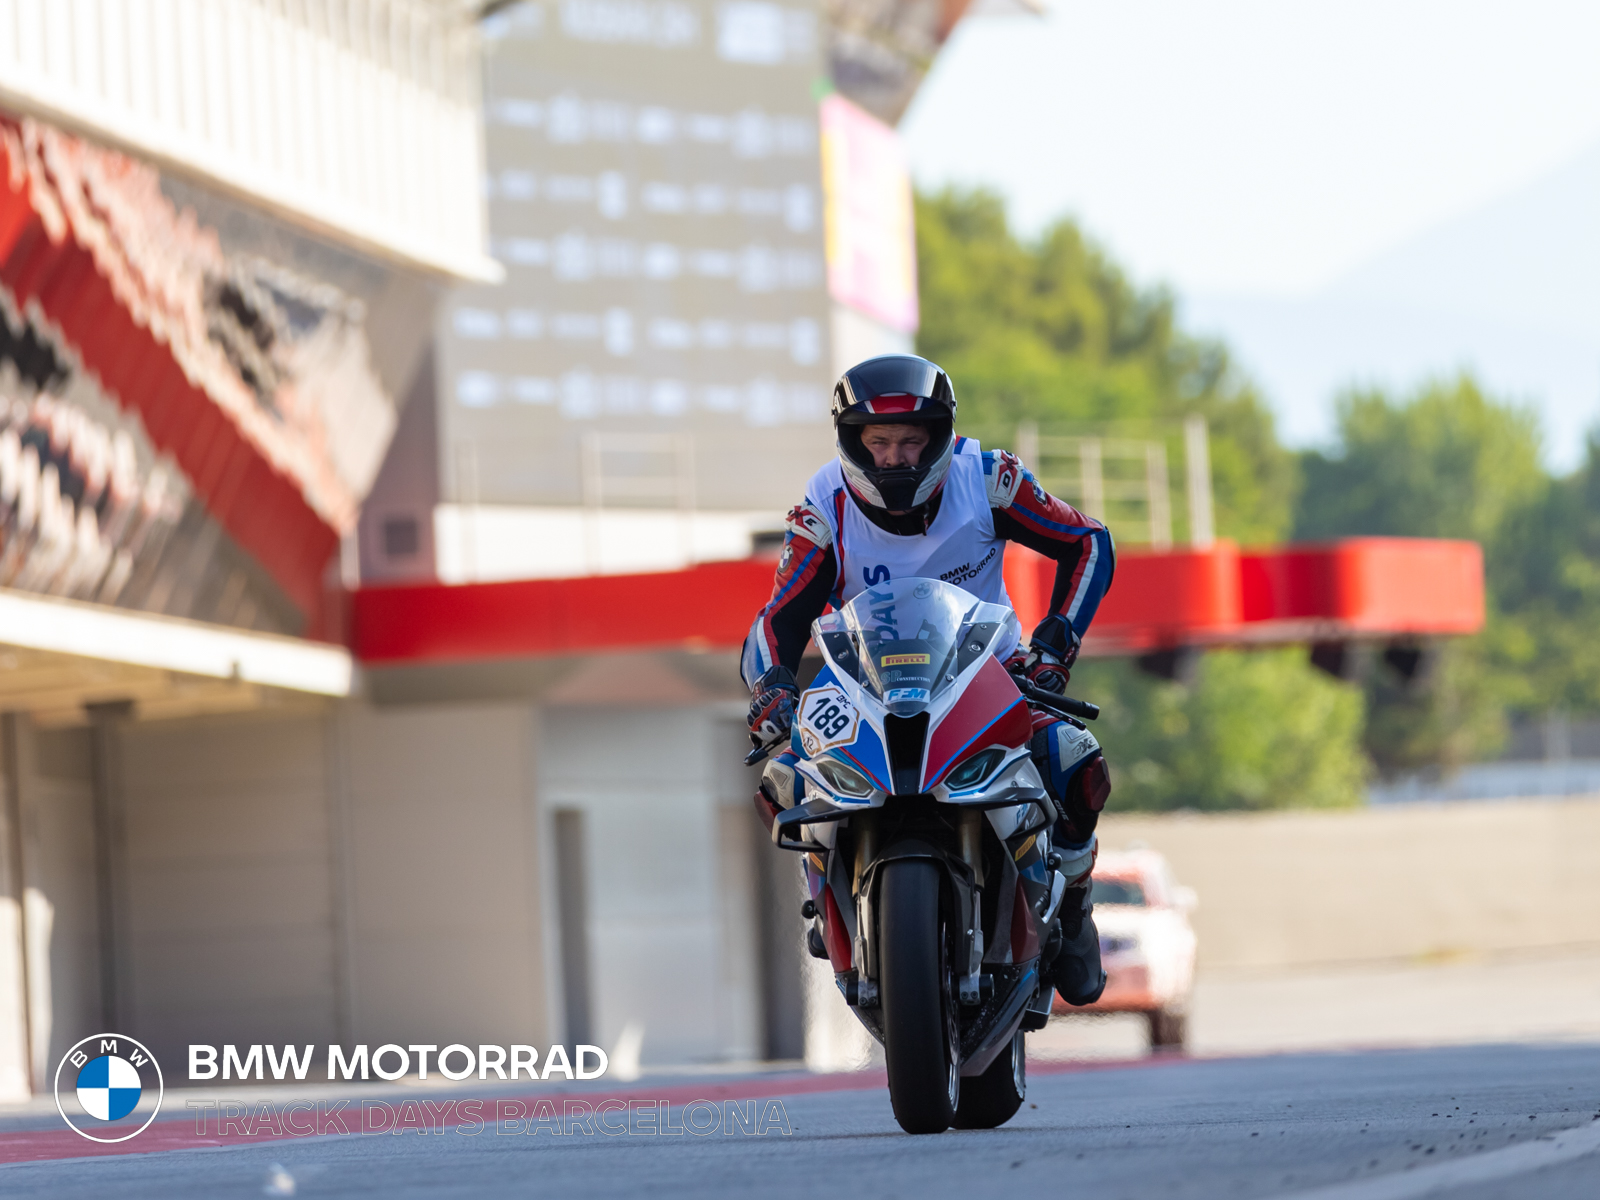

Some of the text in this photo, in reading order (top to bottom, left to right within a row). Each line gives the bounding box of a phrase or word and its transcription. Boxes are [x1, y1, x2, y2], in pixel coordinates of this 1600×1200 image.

[939, 562, 971, 581] BMW
[885, 655, 926, 665] PIRELLI
[807, 697, 850, 740] 189
